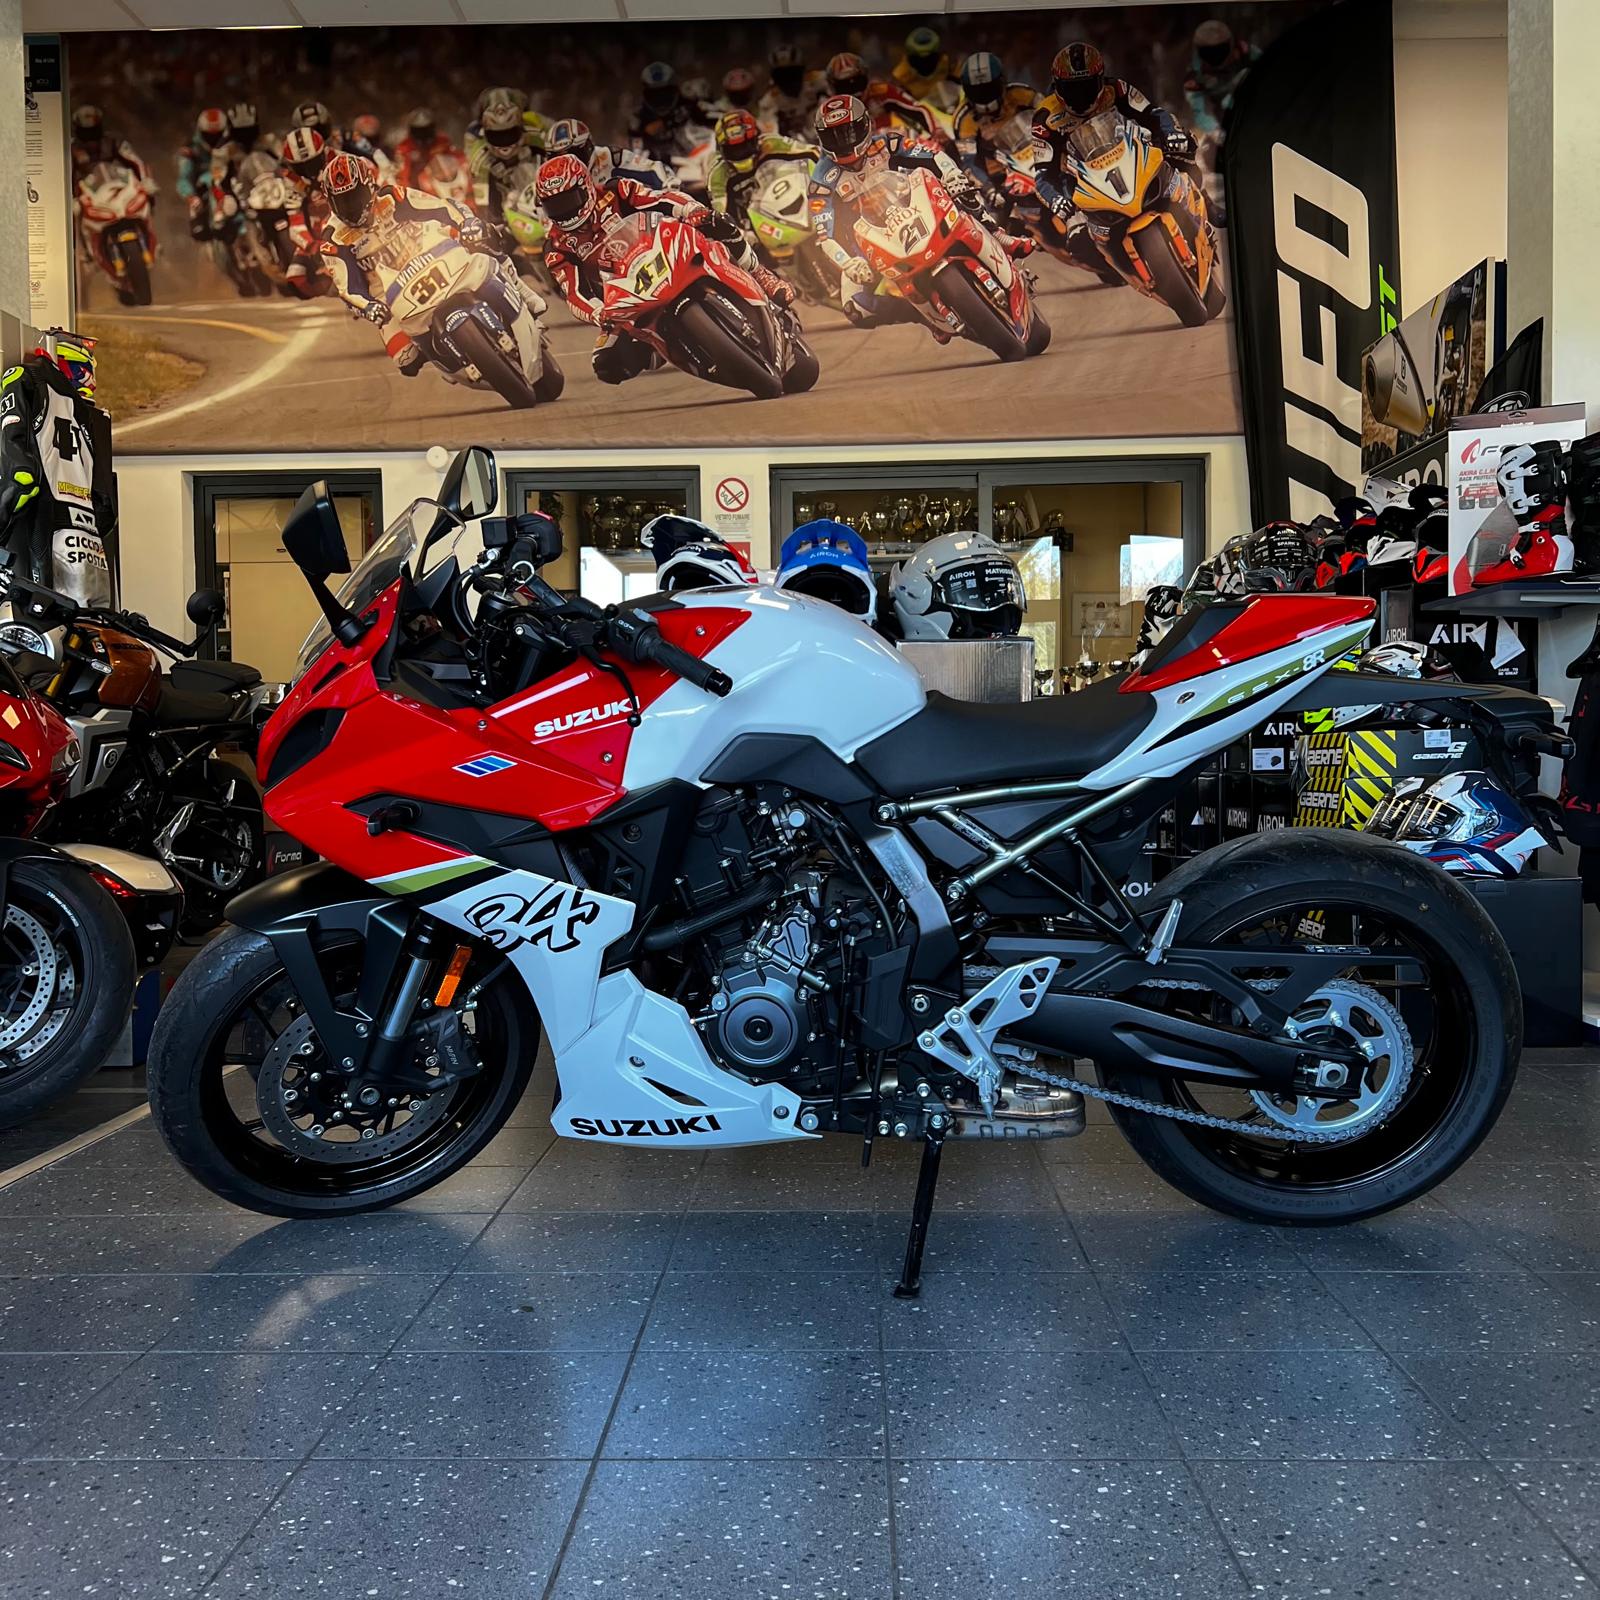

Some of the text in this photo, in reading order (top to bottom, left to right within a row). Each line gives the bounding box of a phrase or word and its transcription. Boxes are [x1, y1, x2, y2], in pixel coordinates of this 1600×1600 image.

[1090, 147, 1125, 168] Corona
[546, 178, 564, 189] Arai
[772, 180, 791, 200] 9
[1105, 166, 1130, 198] 1
[884, 204, 922, 241] XEROX
[899, 215, 931, 256] 21
[634, 251, 669, 295] 41
[410, 266, 450, 305] 31
[809, 551, 839, 559] AIROH
[949, 570, 976, 581] AIROH
[1385, 627, 1407, 642] AIROH
[534, 696, 640, 738] SUZUKI
[1308, 749, 1343, 765] AERNE
[1227, 809, 1247, 829] AIROH
[1257, 814, 1285, 833] AIROH
[274, 851, 302, 864] Forma
[569, 1114, 722, 1137] SUZUKI
